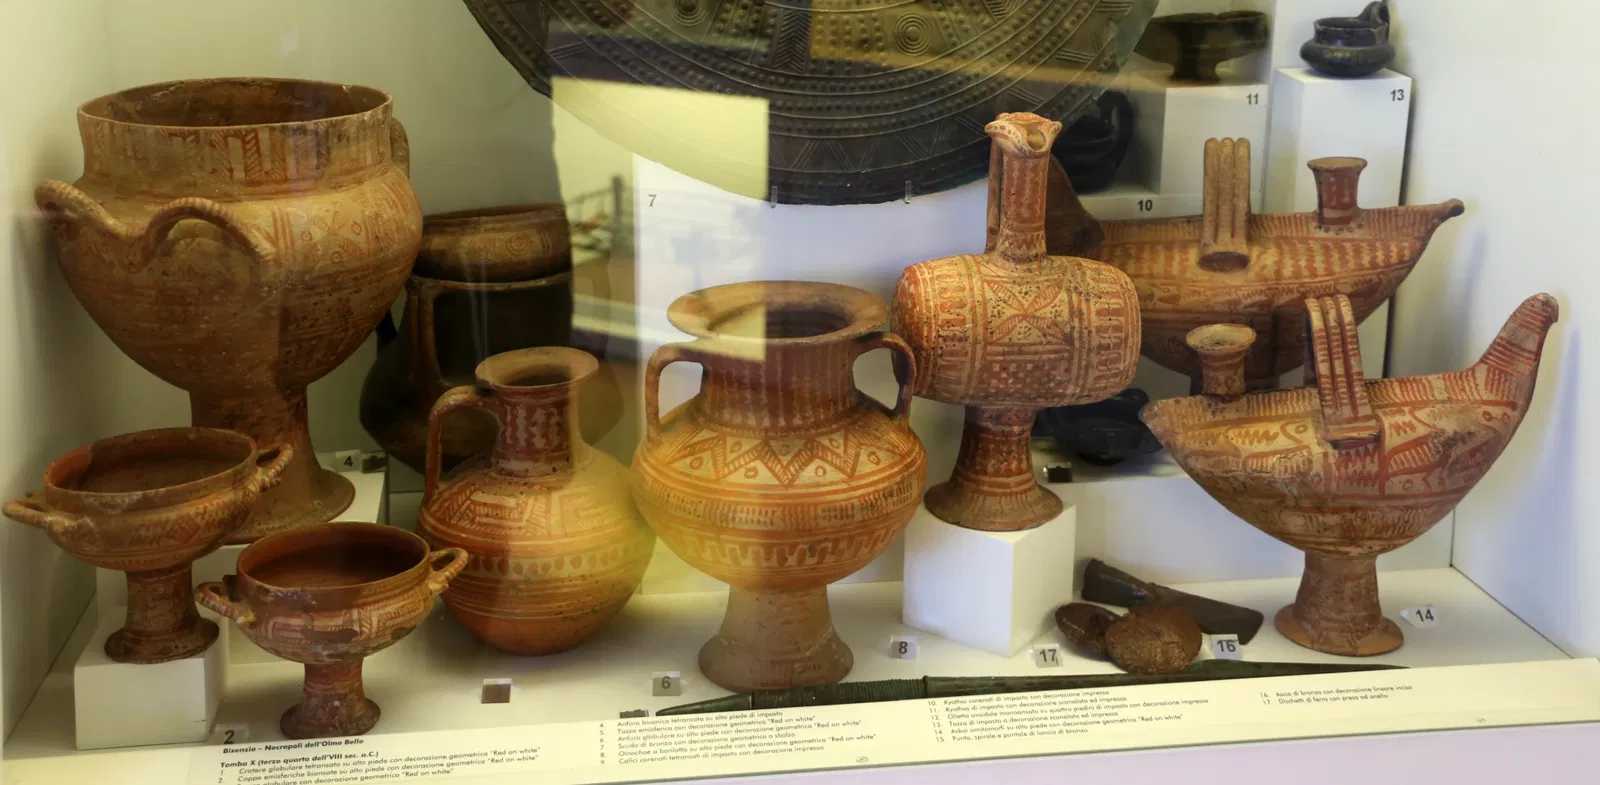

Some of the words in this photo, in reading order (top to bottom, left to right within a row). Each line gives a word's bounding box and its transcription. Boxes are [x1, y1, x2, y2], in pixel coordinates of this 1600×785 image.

[1246, 93, 1259, 105] 11
[1390, 89, 1404, 101] 13
[648, 194, 657, 207] 7
[1137, 200, 1153, 211] 10
[344, 456, 353, 467] 4
[1415, 609, 1434, 622] 14
[899, 641, 908, 654] 8
[1217, 639, 1236, 653] 16
[1039, 649, 1057, 662] 17
[661, 676, 671, 689] 6
[223, 730, 235, 744] 2
[223, 744, 256, 753] Bisenzio
[264, 741, 303, 753] Necropoli
[344, 737, 363, 745] Bello
[221, 759, 248, 768] Tomba
[258, 757, 281, 767] (terzo
[283, 755, 310, 765] quarto
